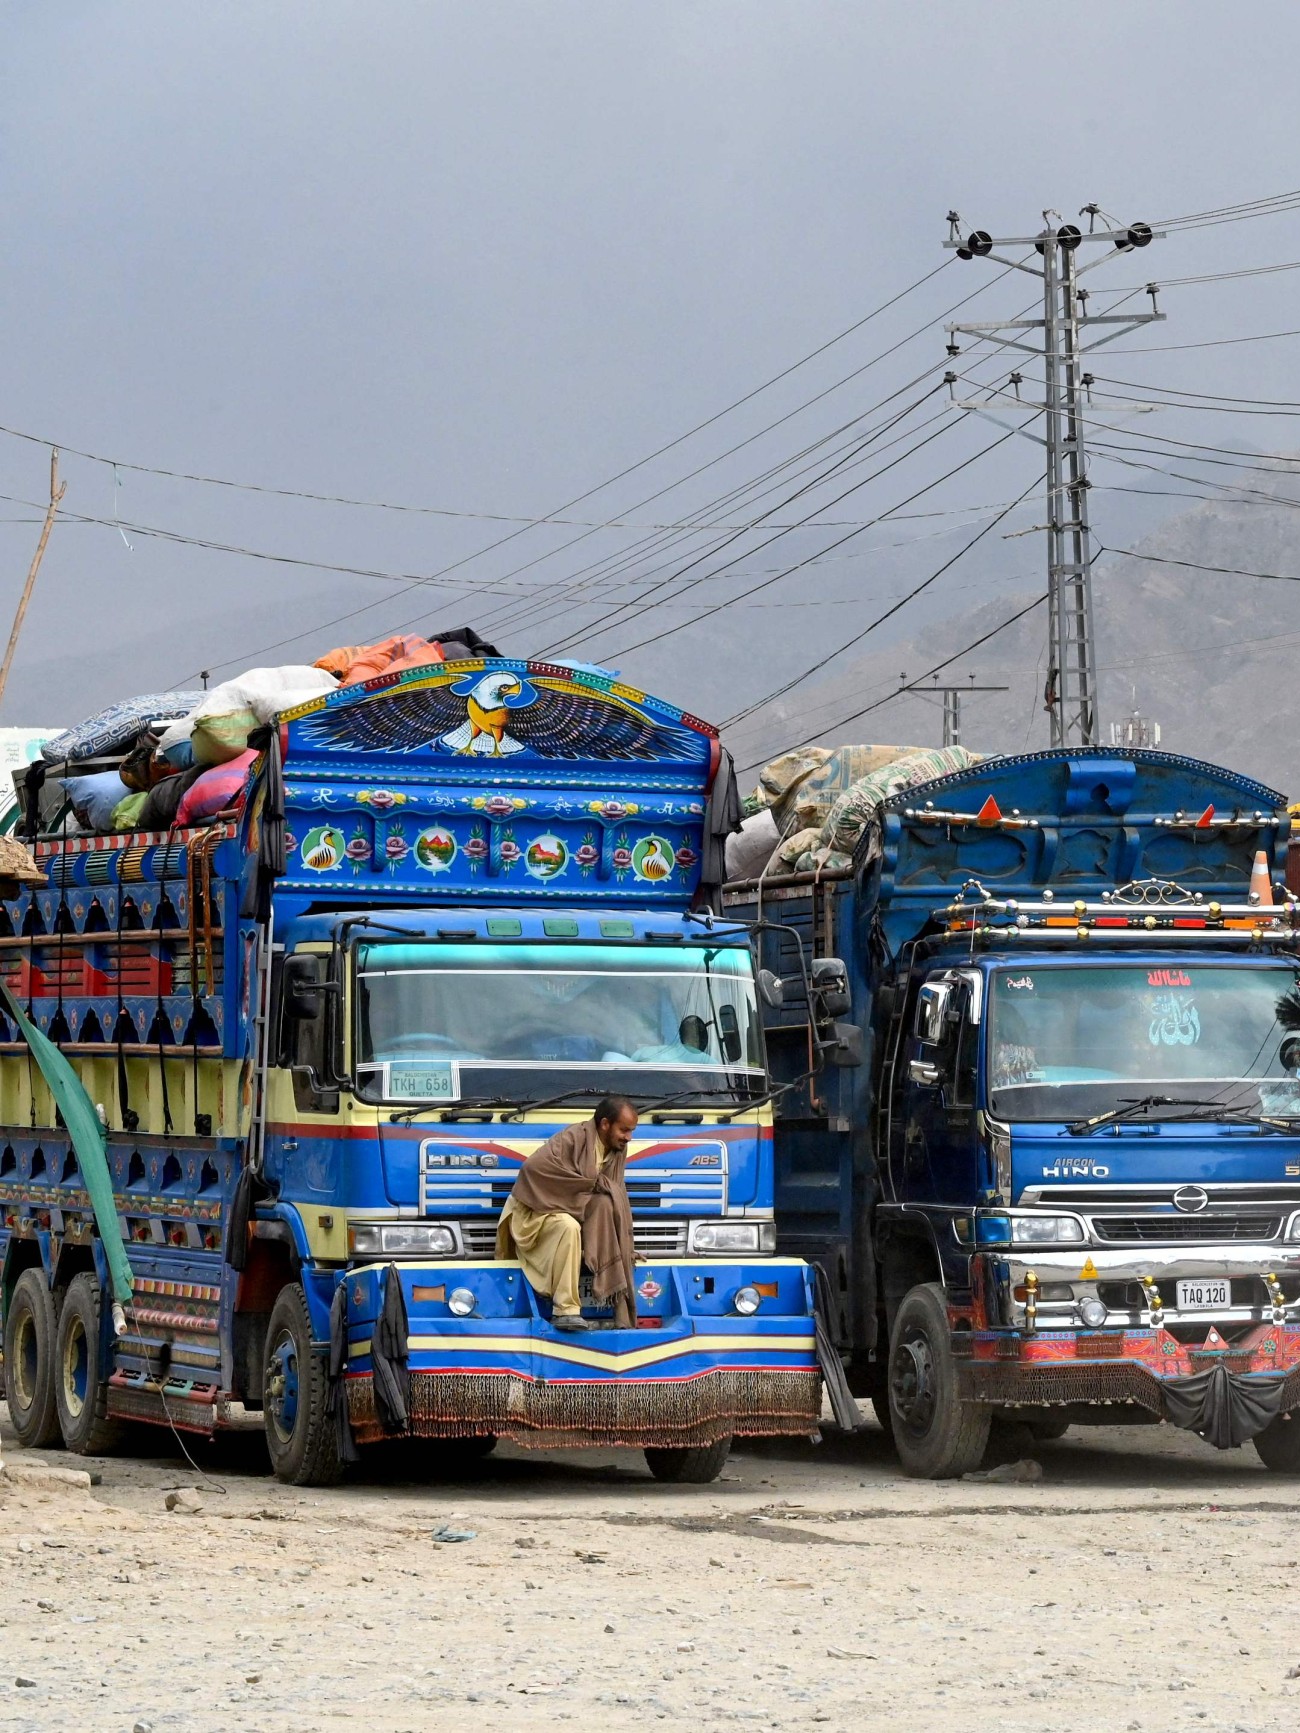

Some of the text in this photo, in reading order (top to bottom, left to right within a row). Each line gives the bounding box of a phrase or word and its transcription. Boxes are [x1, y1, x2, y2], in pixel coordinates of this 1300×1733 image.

[393, 1078, 448, 1091] TKH 658
[428, 1154, 498, 1167] HINO
[688, 1155, 719, 1165] ABS
[1053, 1158, 1096, 1166] AIRCON
[1042, 1166, 1109, 1178] HINO
[1182, 1287, 1226, 1304] TAQ 120
